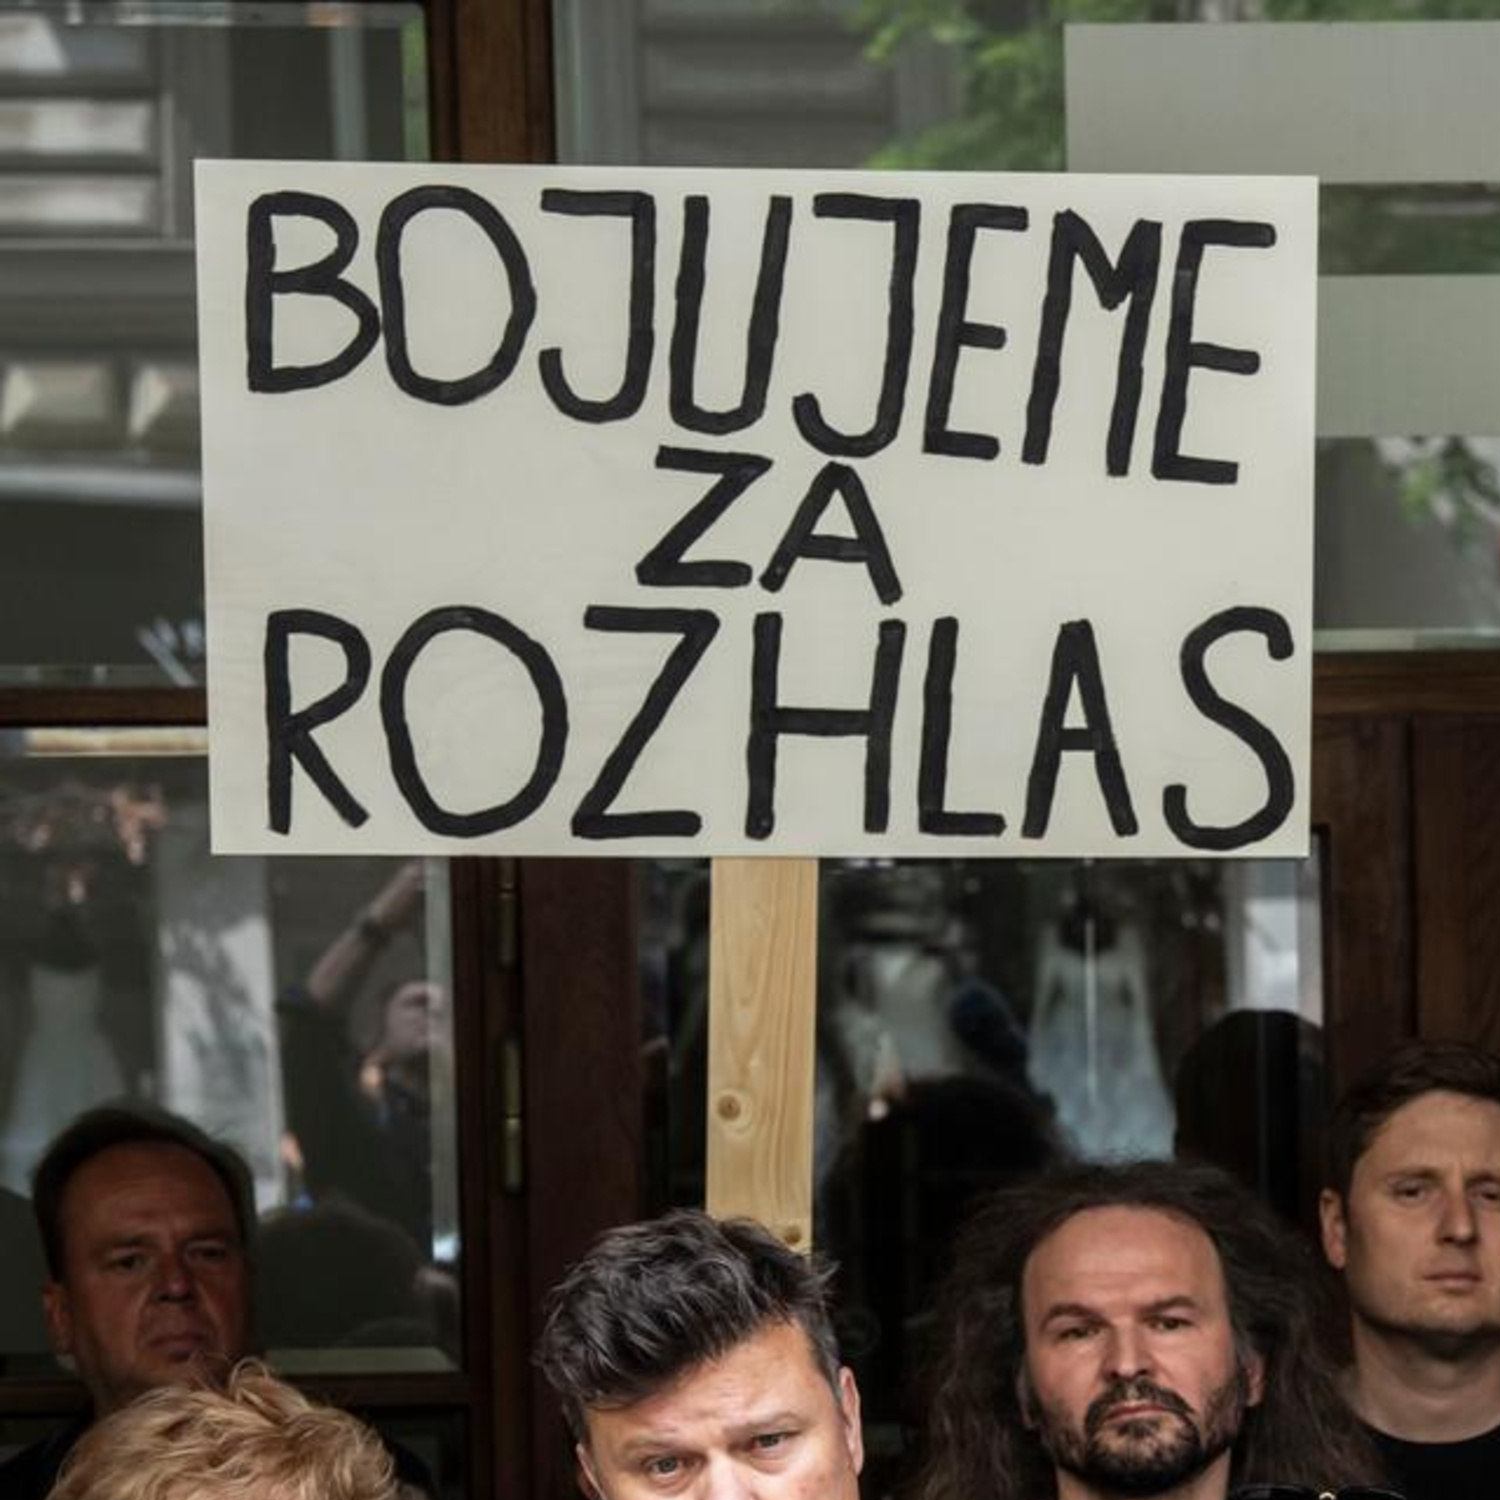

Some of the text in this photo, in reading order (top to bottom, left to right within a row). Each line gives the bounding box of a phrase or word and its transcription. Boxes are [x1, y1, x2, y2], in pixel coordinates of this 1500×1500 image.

[245, 184, 1278, 485] BOJUJEME
[635, 445, 903, 606] ZA
[263, 605, 1296, 852] ROZHLAS
